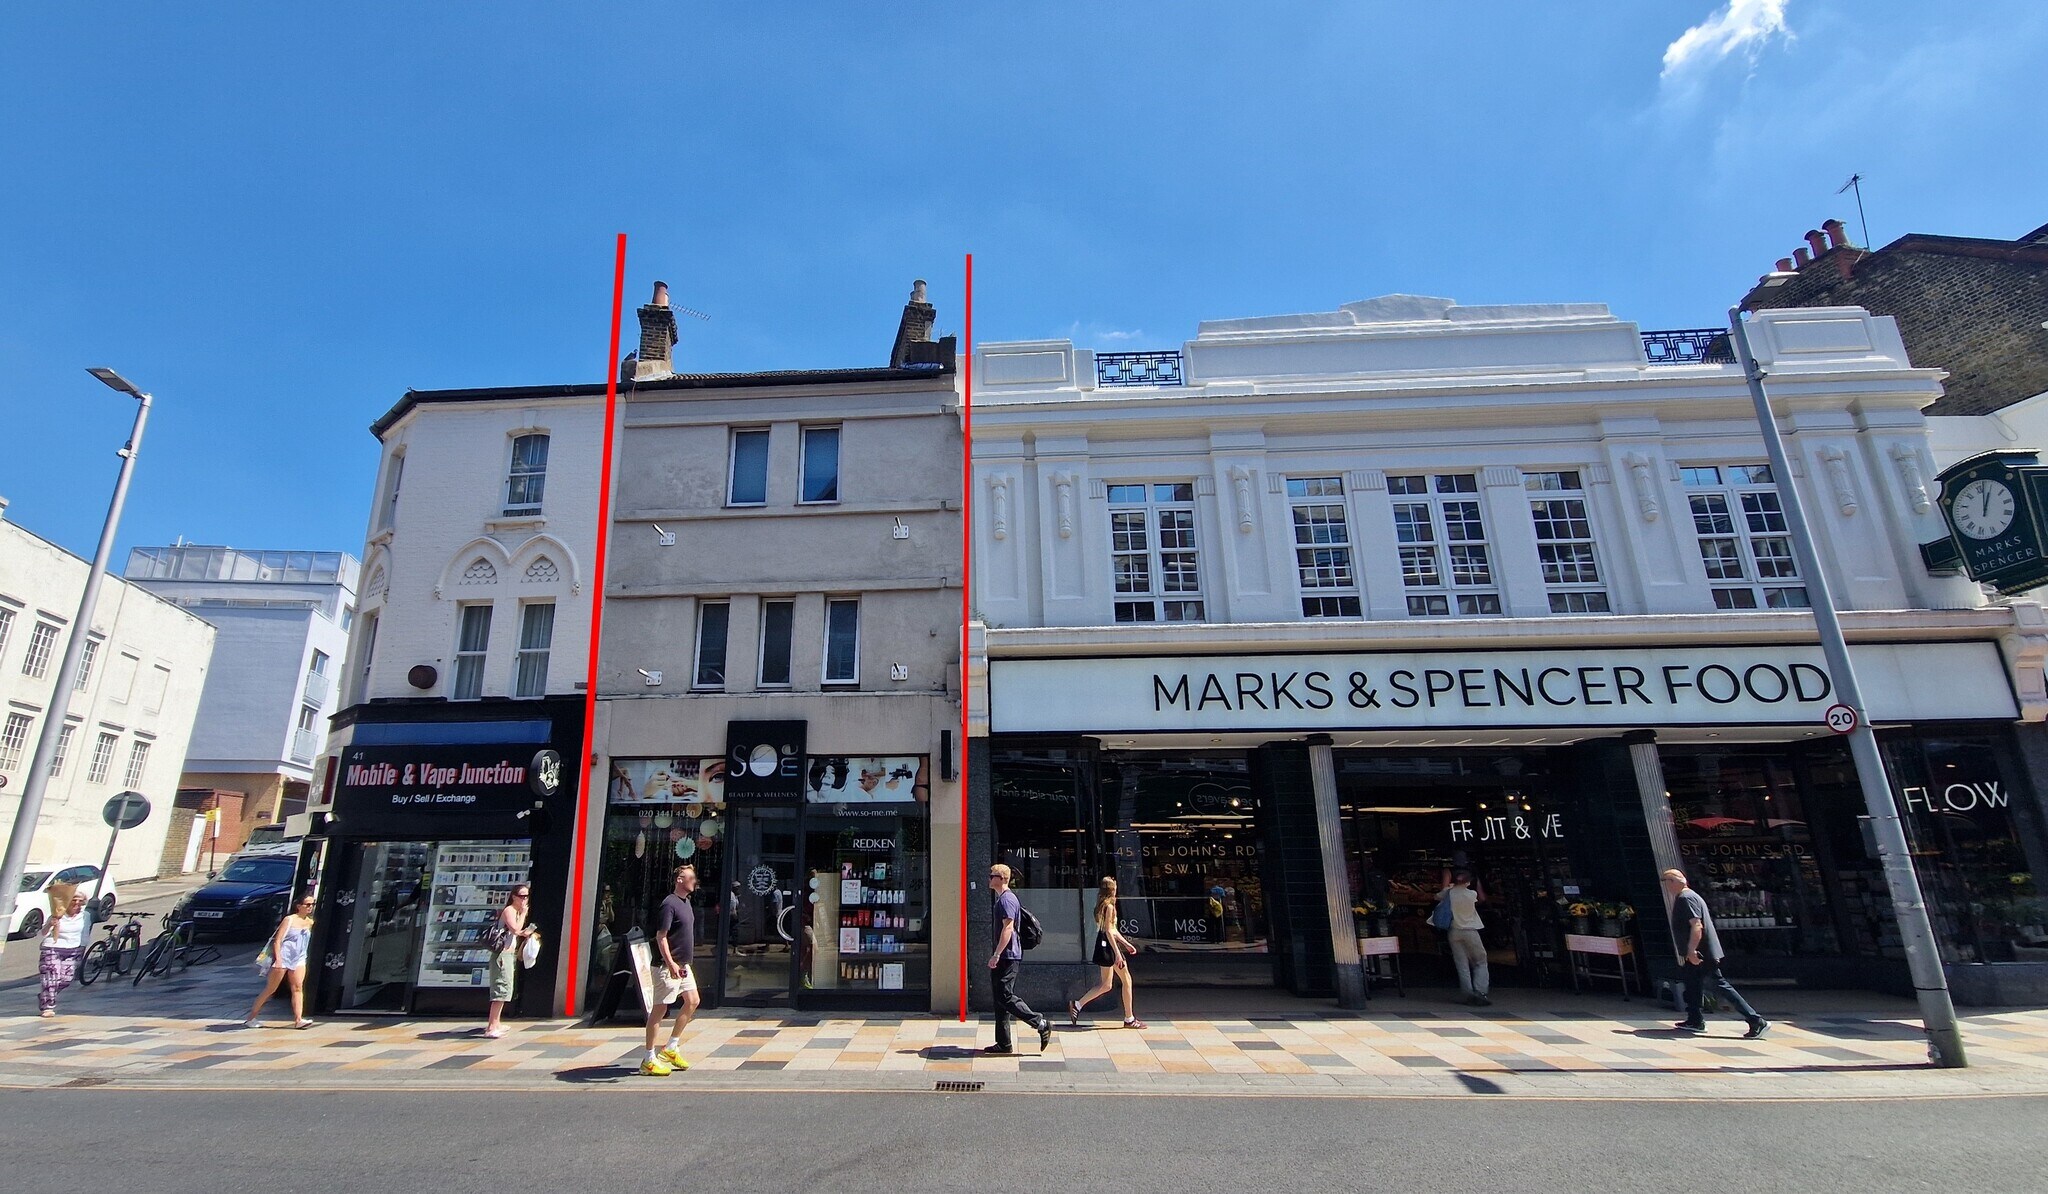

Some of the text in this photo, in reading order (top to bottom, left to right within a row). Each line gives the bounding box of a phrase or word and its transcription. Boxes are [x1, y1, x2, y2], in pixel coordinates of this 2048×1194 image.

[1976, 536, 2021, 558] MARKS
[1974, 547, 2035, 574] SPENCER
[1152, 663, 1832, 711] MARKS & SPENCER FOOD
[1831, 713, 1853, 726] 20
[352, 752, 364, 761] 41
[346, 762, 398, 786] Mobile
[402, 763, 415, 786] &
[420, 762, 456, 788] Vape
[458, 760, 525, 785] Junction
[392, 795, 408, 804] Buy
[414, 794, 430, 803] Sell
[436, 794, 476, 804] Exchange
[639, 810, 654, 818] 020
[838, 809, 898, 817] www.so-me.me
[1514, 815, 1531, 839] &
[852, 838, 896, 848] REDKEN
[1115, 846, 1134, 857] 45
[1142, 845, 1160, 857] ST
[1235, 845, 1256, 856] RD
[1681, 844, 1806, 856] ST JOHN'S RD
[1119, 919, 1140, 934] &S
[1174, 918, 1207, 934] M&S
